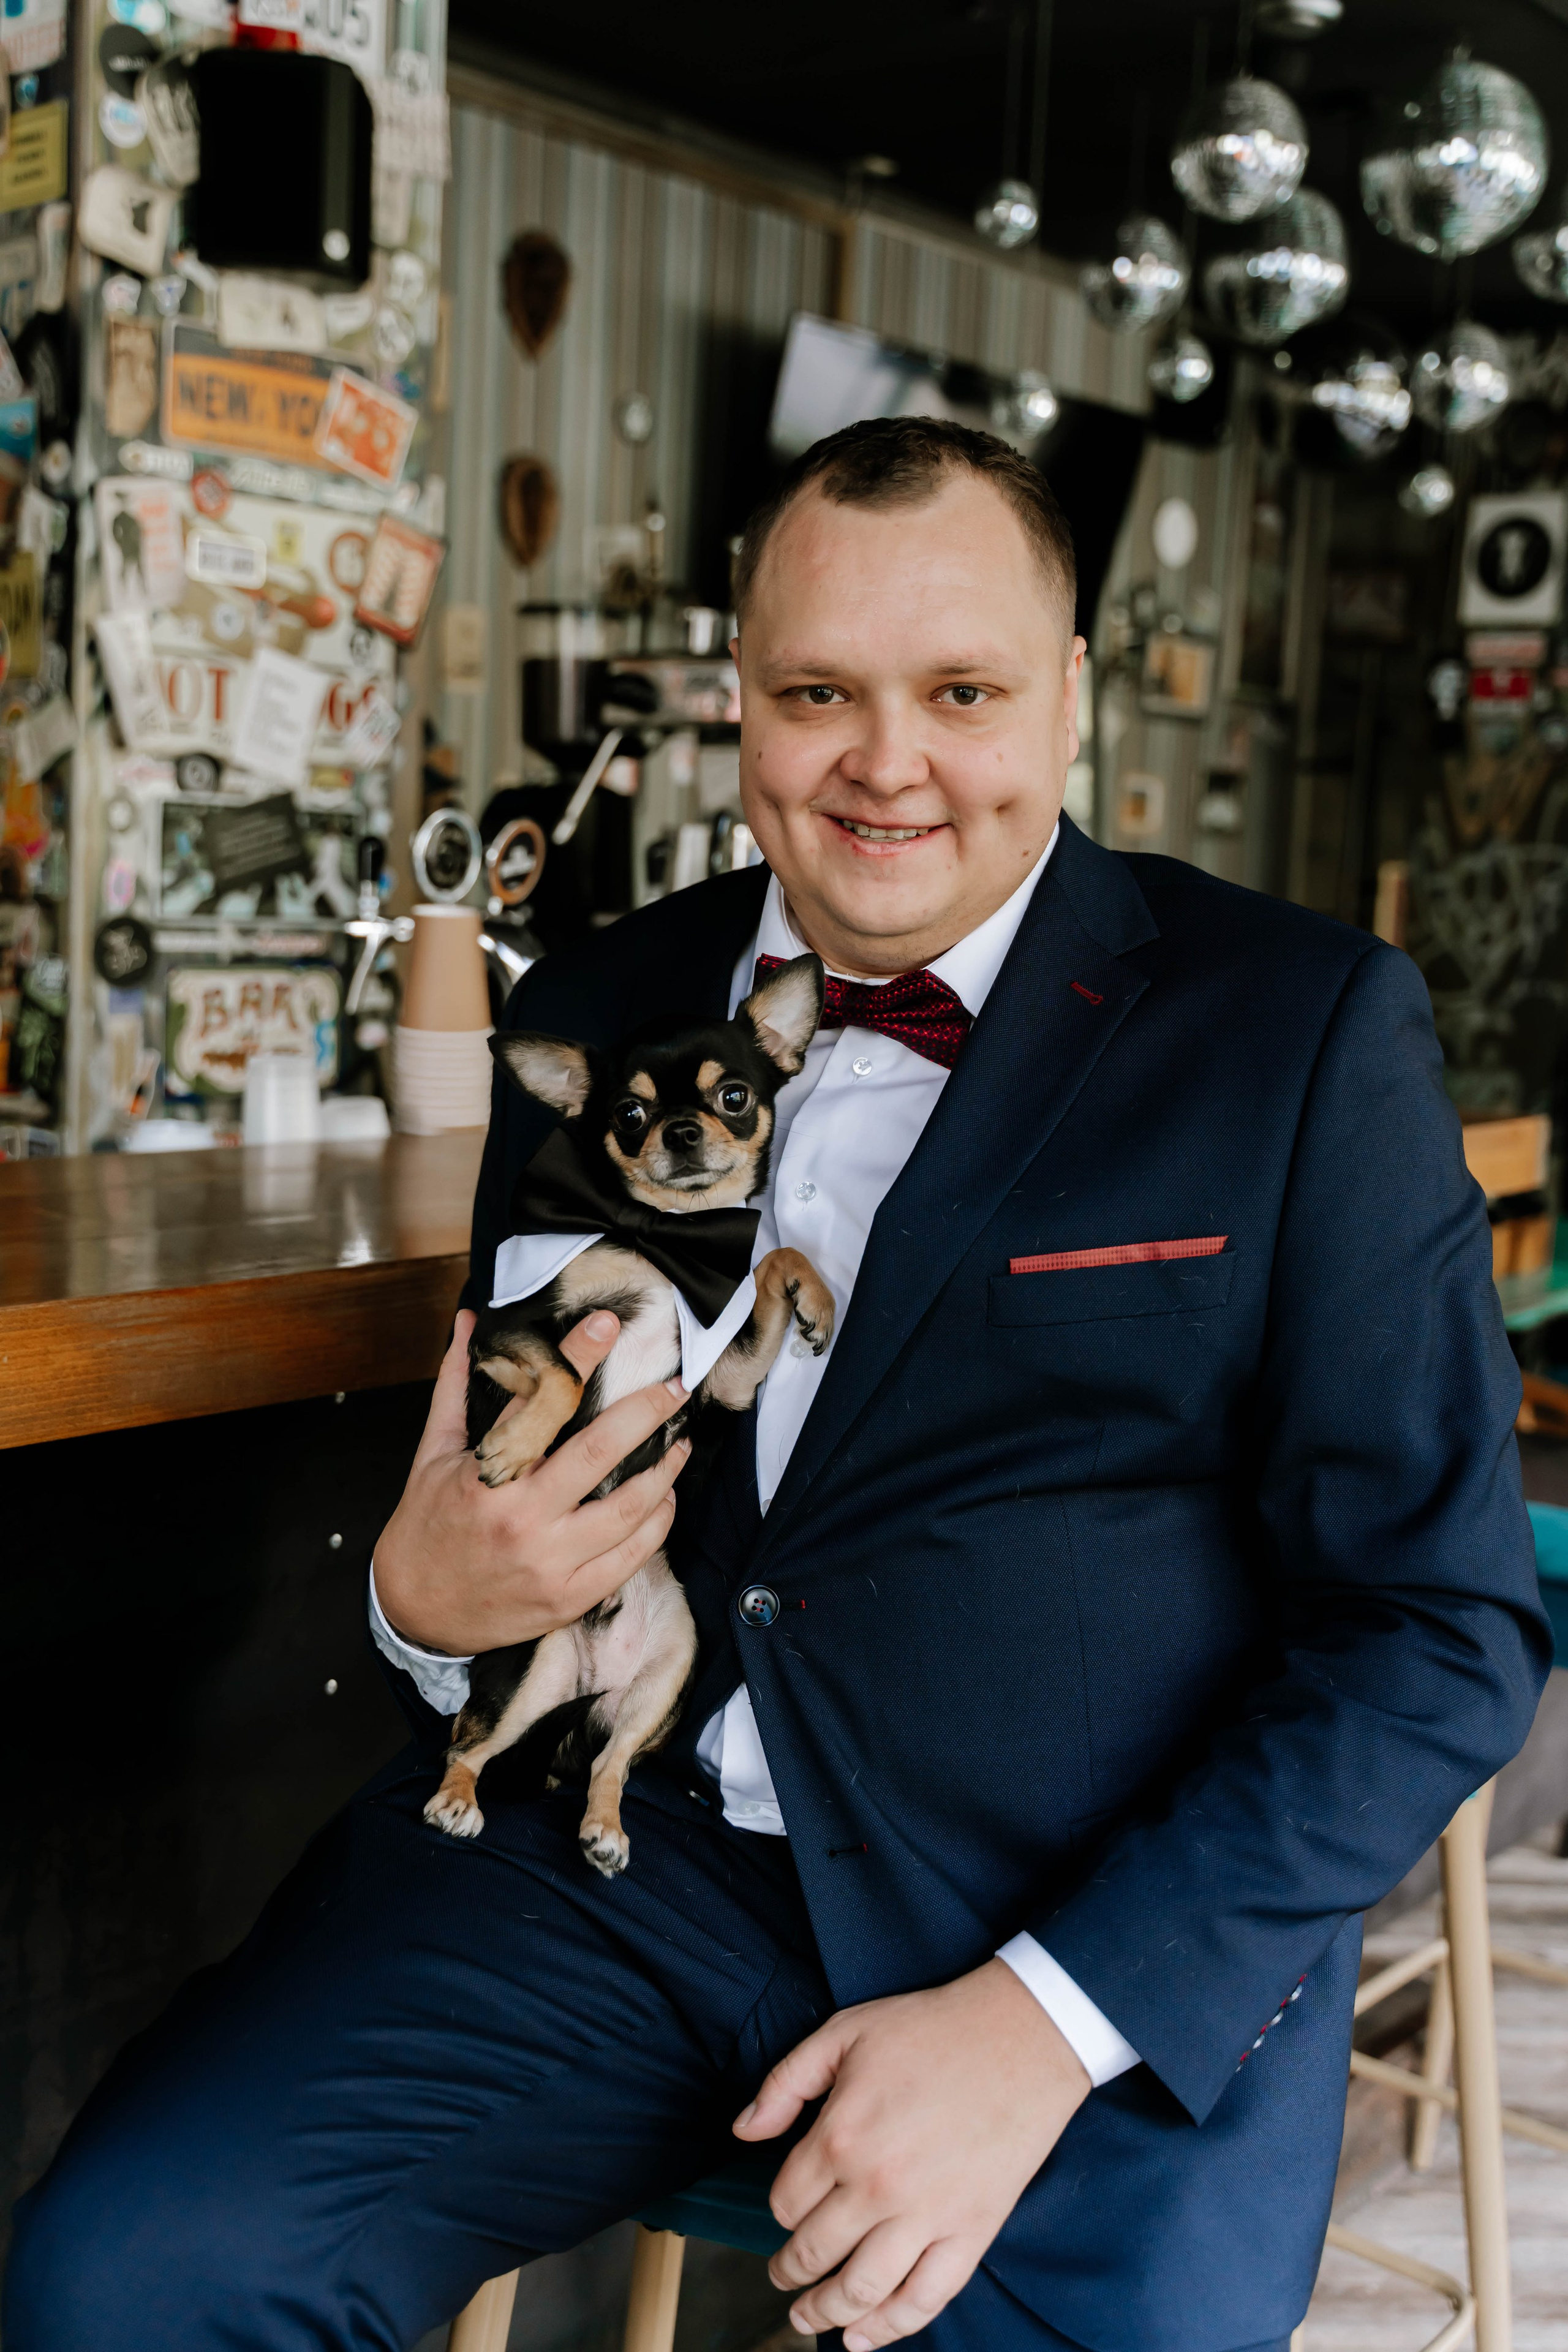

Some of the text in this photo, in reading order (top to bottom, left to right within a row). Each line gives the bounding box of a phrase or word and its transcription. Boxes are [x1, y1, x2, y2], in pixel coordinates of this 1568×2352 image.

[178, 369, 320, 437] NEW YO
[157, 663, 230, 723] OT
[200, 982, 299, 1038] BAR
